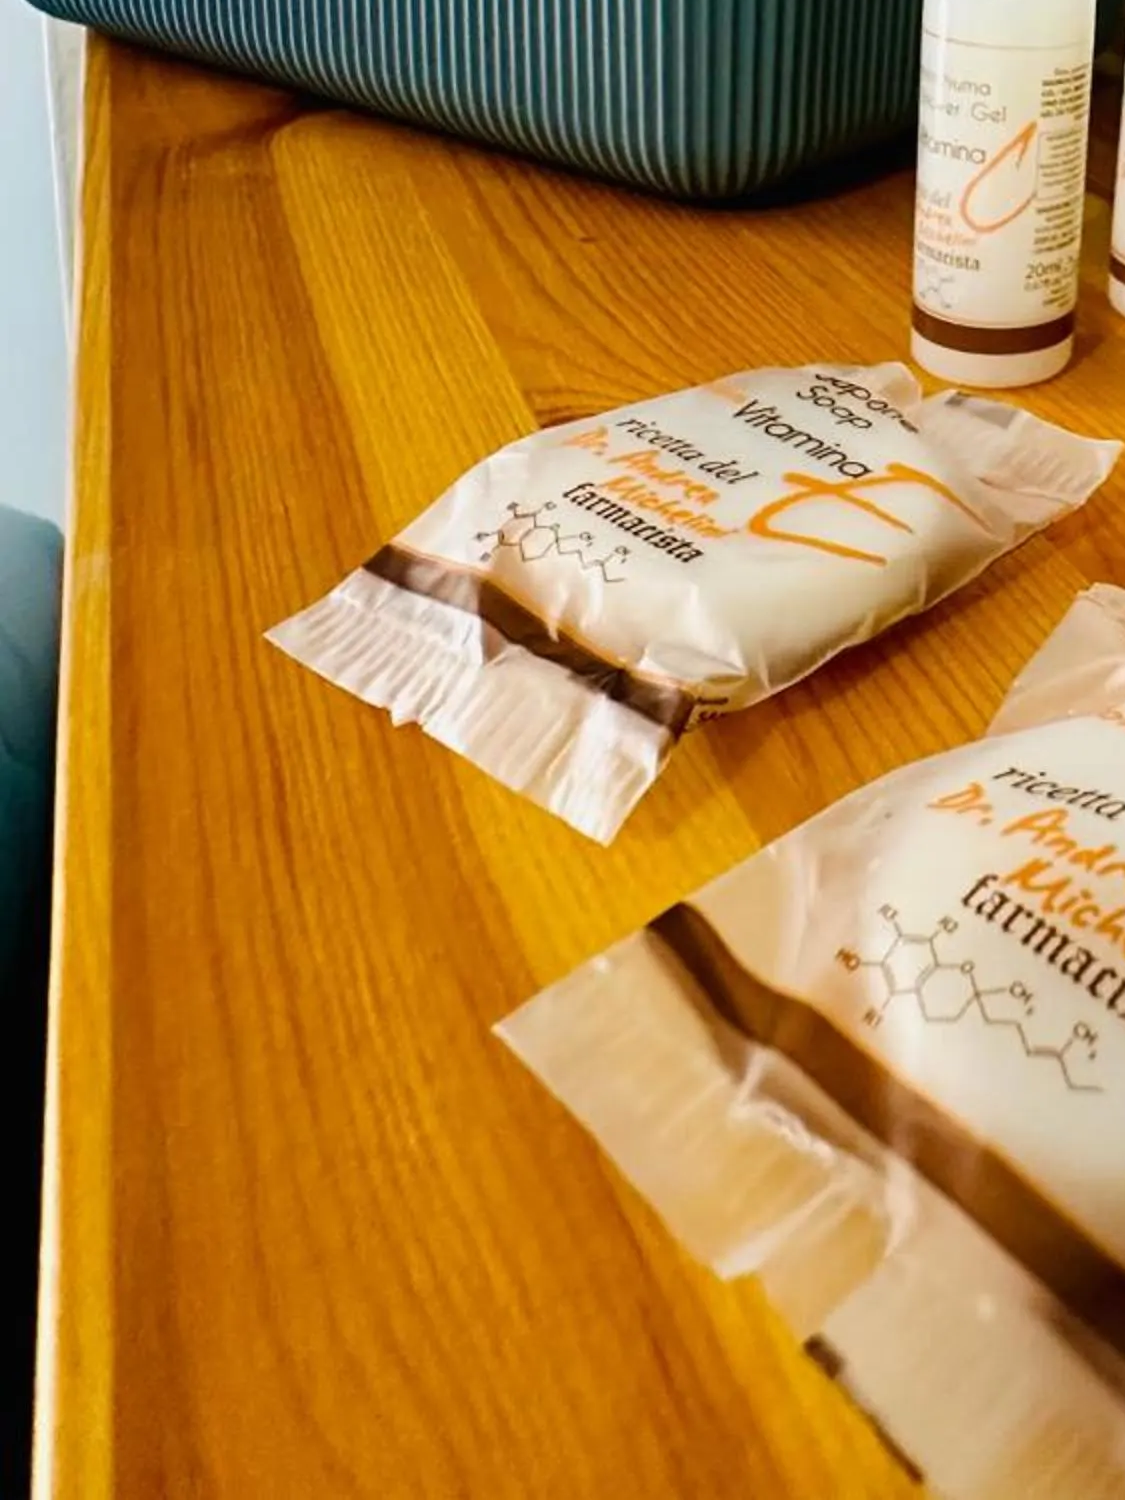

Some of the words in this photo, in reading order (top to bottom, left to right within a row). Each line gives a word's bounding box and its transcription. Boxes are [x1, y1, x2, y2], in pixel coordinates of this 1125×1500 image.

[970, 102, 1007, 123] Gel
[796, 384, 873, 431] Soap
[616, 416, 705, 463] ricetta
[699, 458, 761, 487] del
[732, 398, 874, 479] Vitamina
[562, 481, 705, 564] farmacista
[926, 781, 995, 826] Dr.
